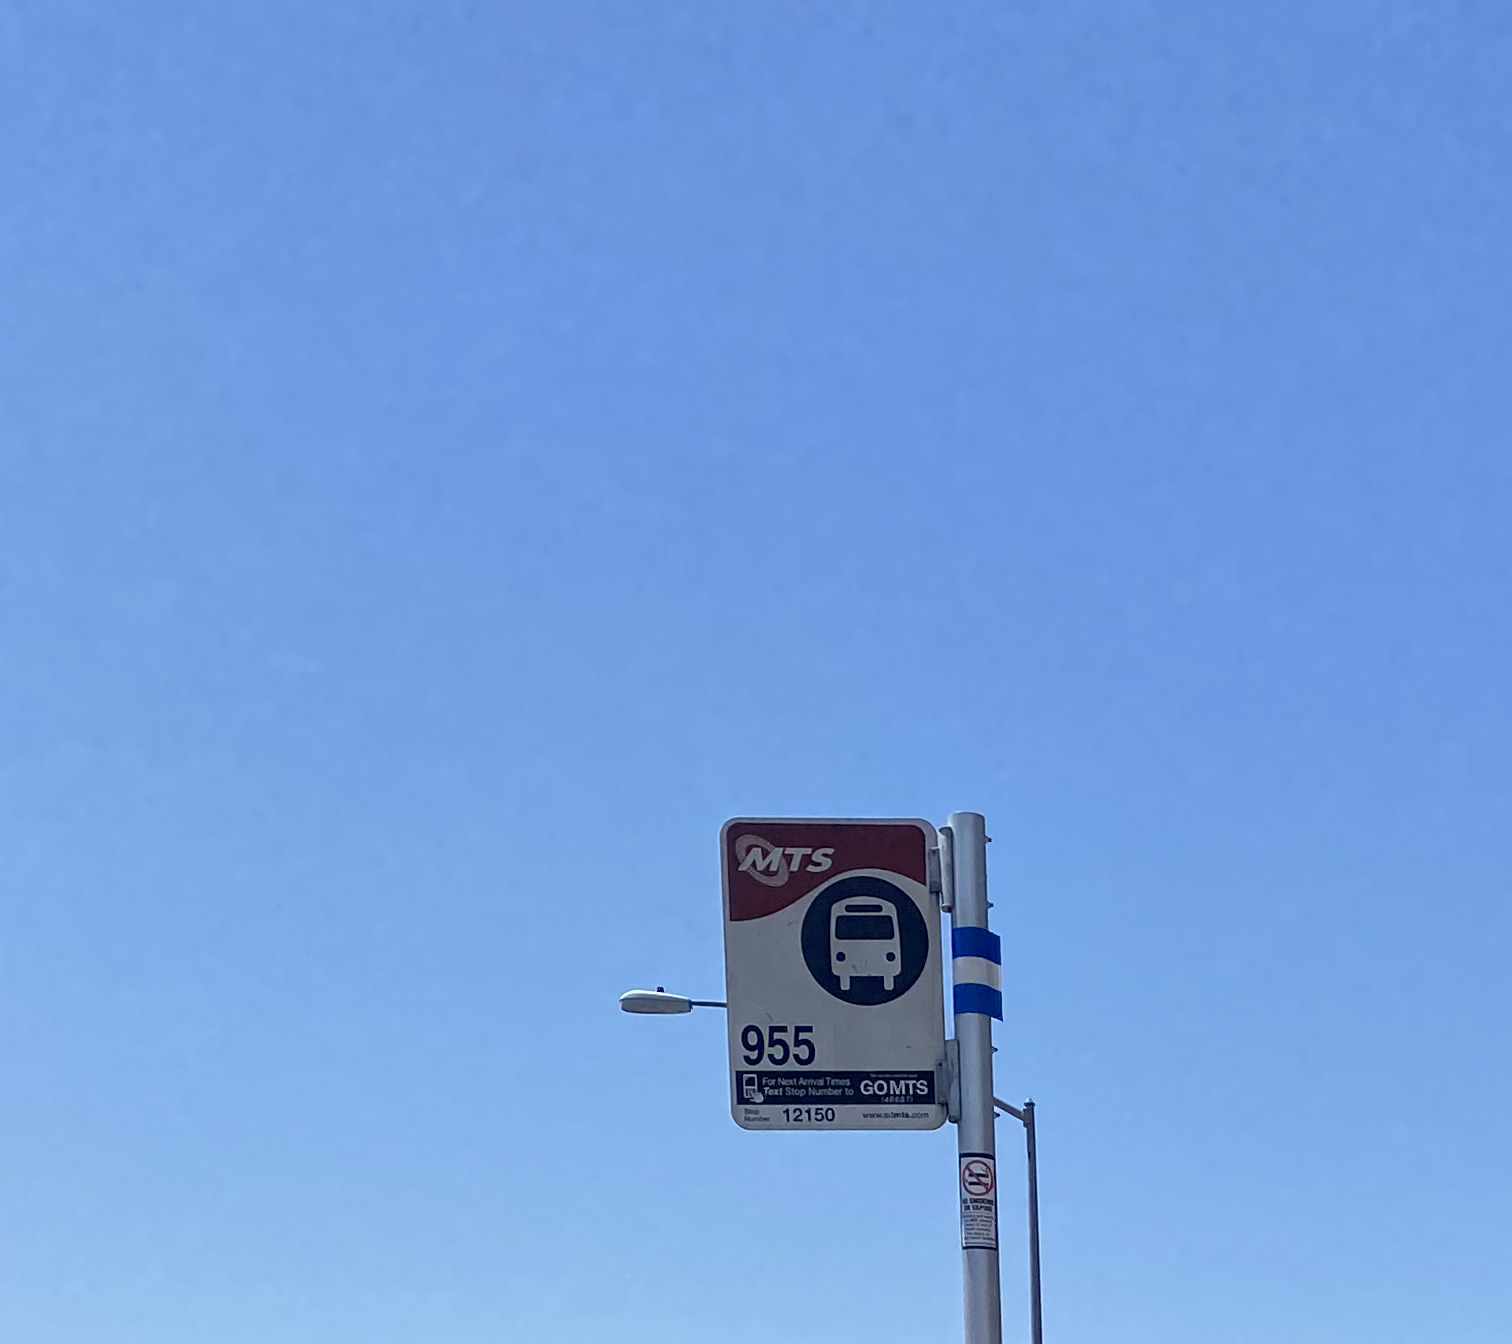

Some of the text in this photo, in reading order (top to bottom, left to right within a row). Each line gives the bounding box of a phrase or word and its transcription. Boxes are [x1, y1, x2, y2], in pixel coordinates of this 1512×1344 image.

[738, 846, 835, 874] MTS
[741, 1024, 816, 1066] 955
[762, 1077, 777, 1086] For
[778, 1077, 797, 1086] Next
[825, 1077, 851, 1086] Times
[763, 1087, 855, 1098] Text Stop Number to
[782, 1108, 836, 1122] 12150
